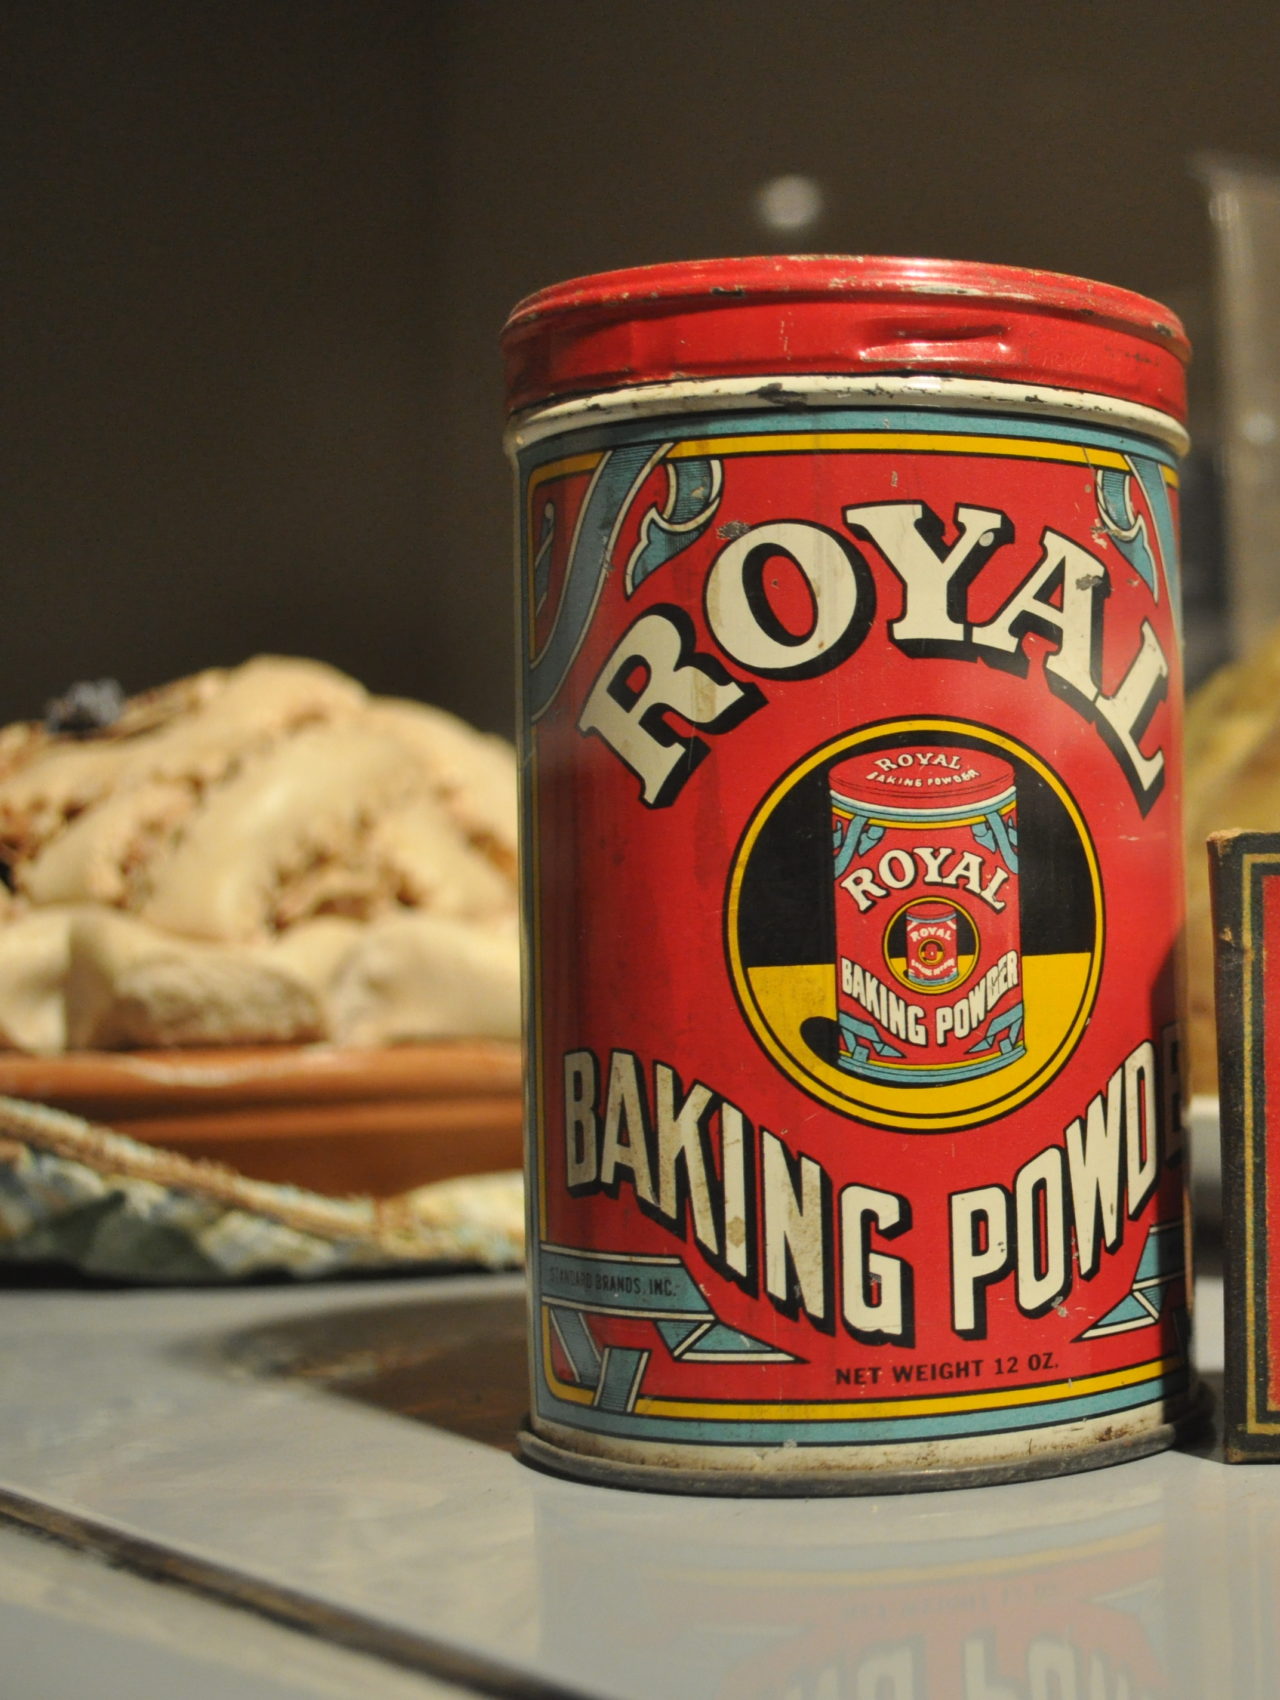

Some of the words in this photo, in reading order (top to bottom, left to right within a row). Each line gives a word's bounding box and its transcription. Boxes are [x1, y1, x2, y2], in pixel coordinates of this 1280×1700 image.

[577, 501, 1170, 810] ROYAL
[865, 771, 923, 788] BAKING
[927, 769, 980, 786] POWDER
[873, 752, 962, 772] ROYAL
[841, 847, 1011, 912] ROYAL
[910, 926, 952, 943] ROYAL
[841, 956, 928, 1047] BAKING
[936, 950, 1019, 1047] POWDER
[562, 1048, 917, 1348] BAKING
[649, 1278, 678, 1298] INC.
[835, 1368, 882, 1385] NET
[892, 1359, 984, 1382] WEIGHT
[994, 1356, 1019, 1375] 12
[1027, 1352, 1059, 1371] OZ.
